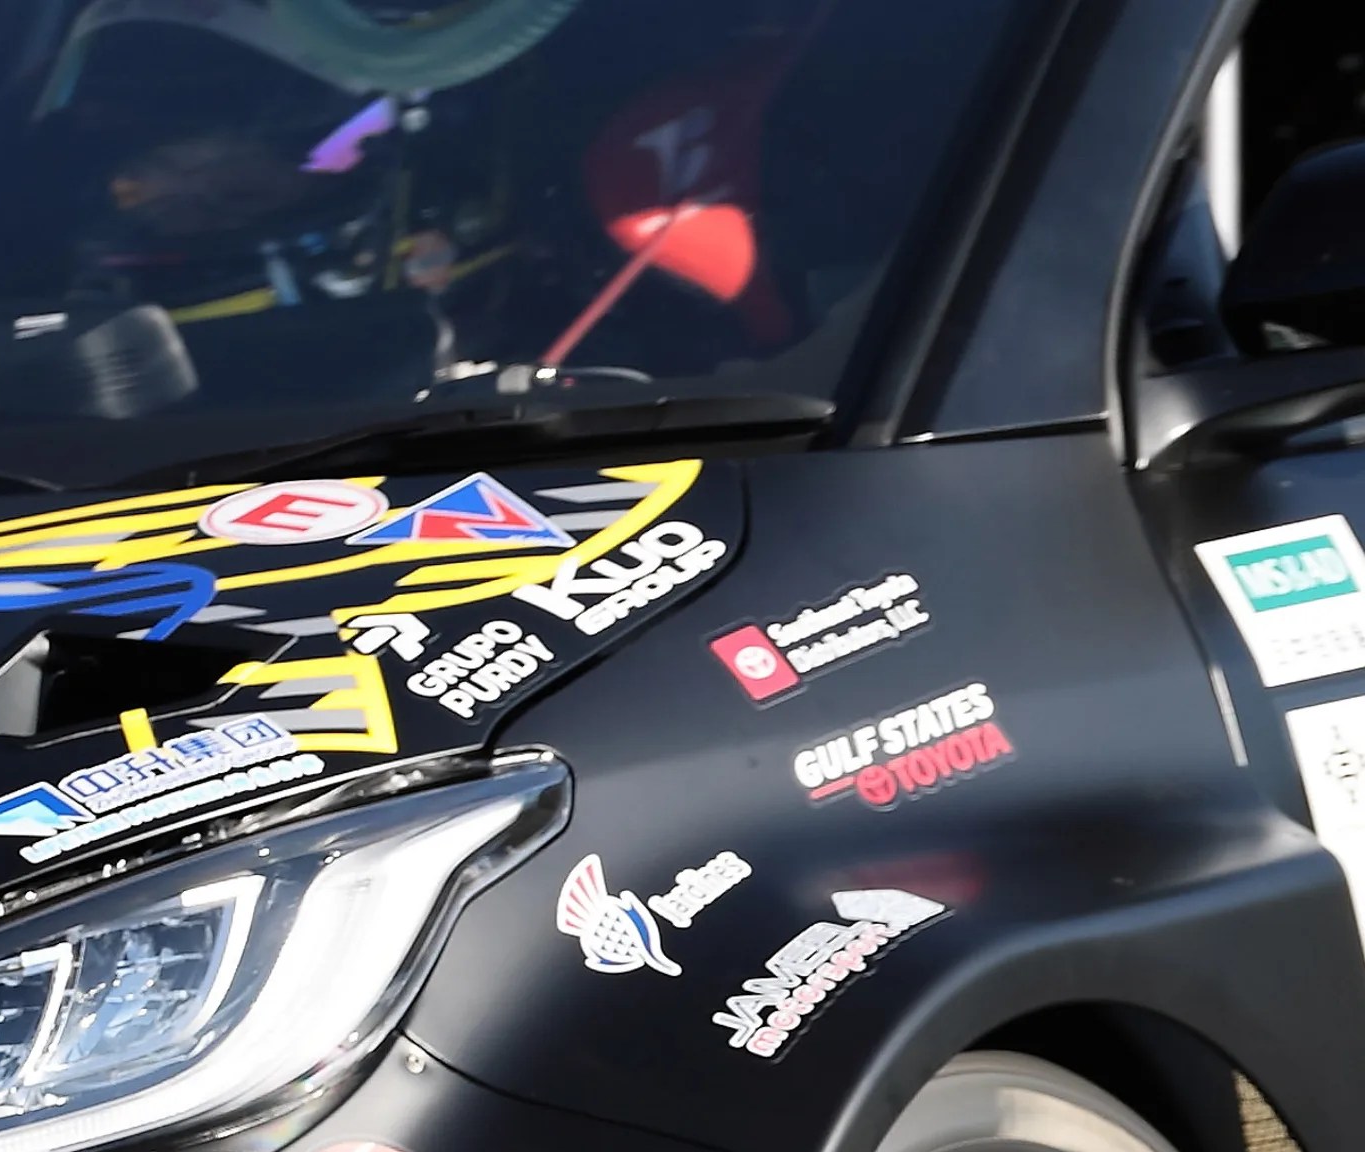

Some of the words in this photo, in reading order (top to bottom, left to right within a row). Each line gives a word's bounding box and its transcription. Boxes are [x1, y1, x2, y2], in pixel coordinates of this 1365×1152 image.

[512, 520, 706, 619] KUO
[575, 538, 727, 636] GROUP
[406, 619, 524, 698] GRUPO
[439, 634, 555, 719] PURDY
[794, 726, 881, 788] GULF
[879, 683, 994, 755] STATES
[896, 723, 1013, 793] TOYOTA
